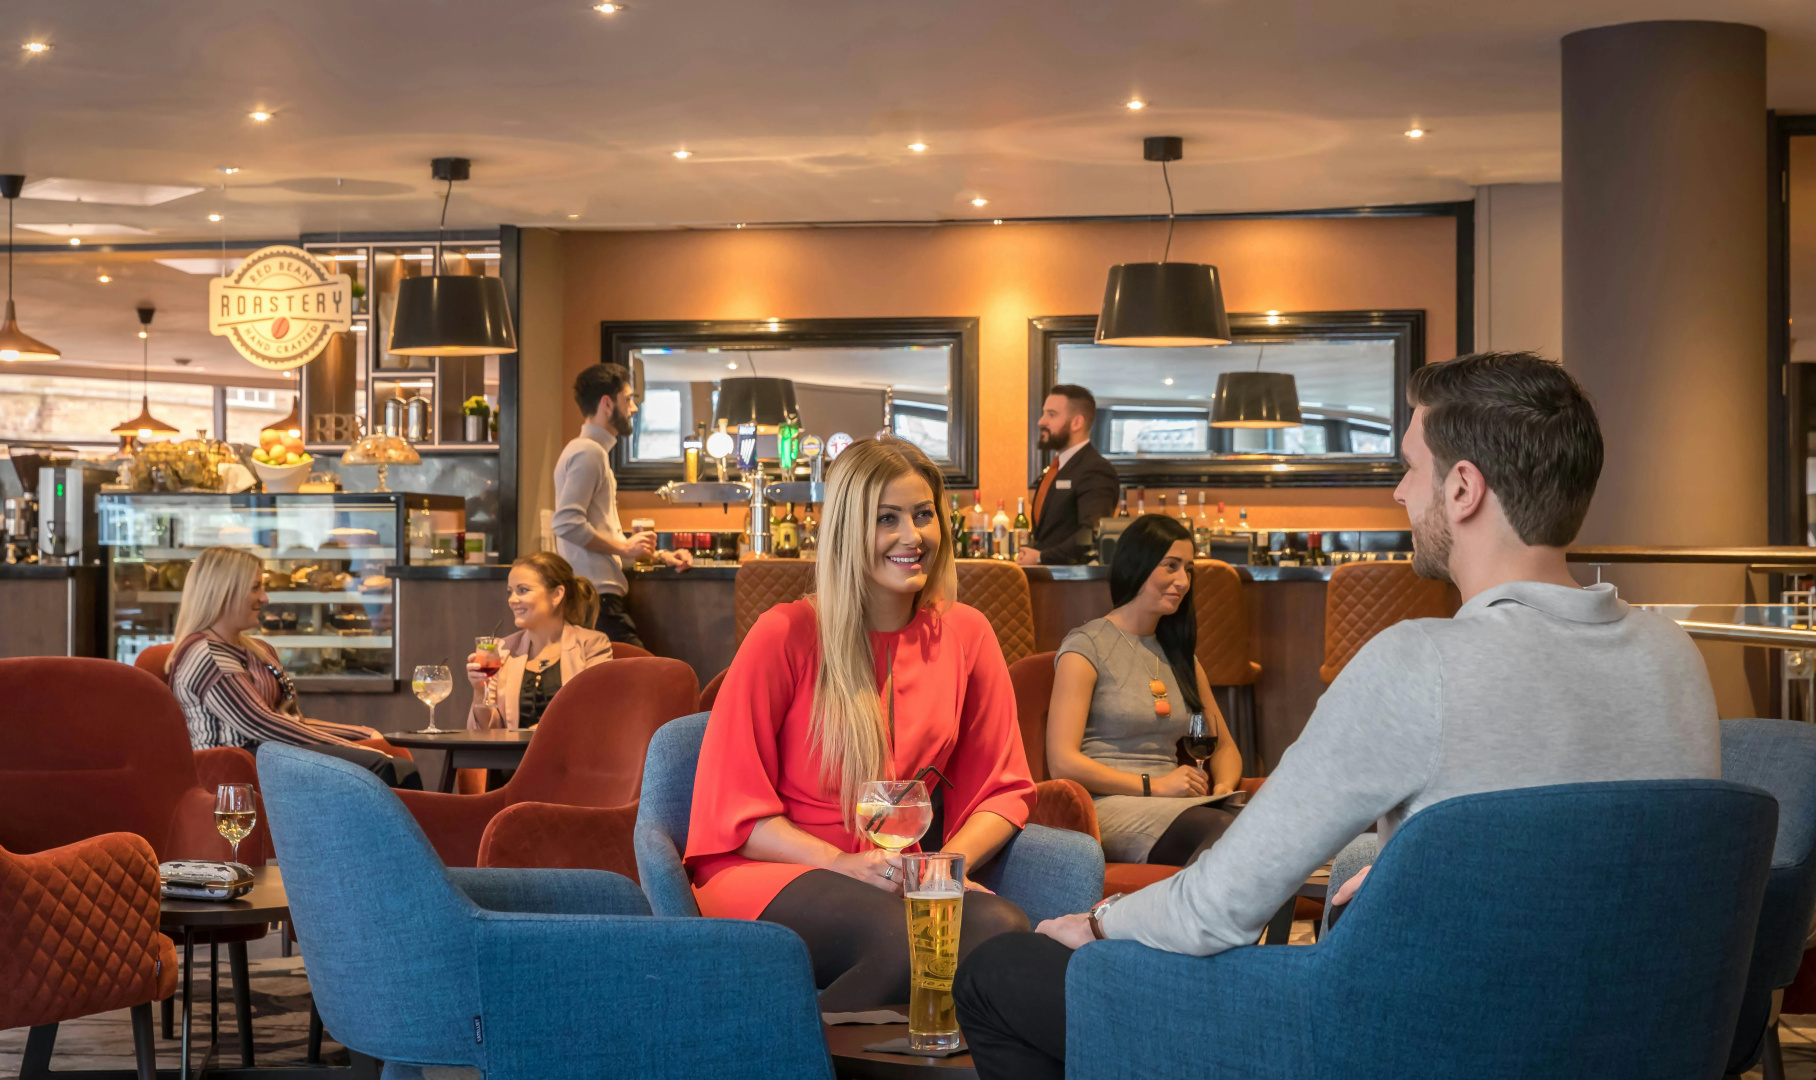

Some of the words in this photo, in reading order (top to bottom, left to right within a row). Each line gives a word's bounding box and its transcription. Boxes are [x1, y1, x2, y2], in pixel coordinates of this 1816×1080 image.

[249, 264, 272, 282] RED
[279, 261, 312, 282] BEAN
[221, 290, 342, 317] ROASTERY
[244, 327, 270, 351] HAND
[276, 325, 318, 354] CRAFTED
